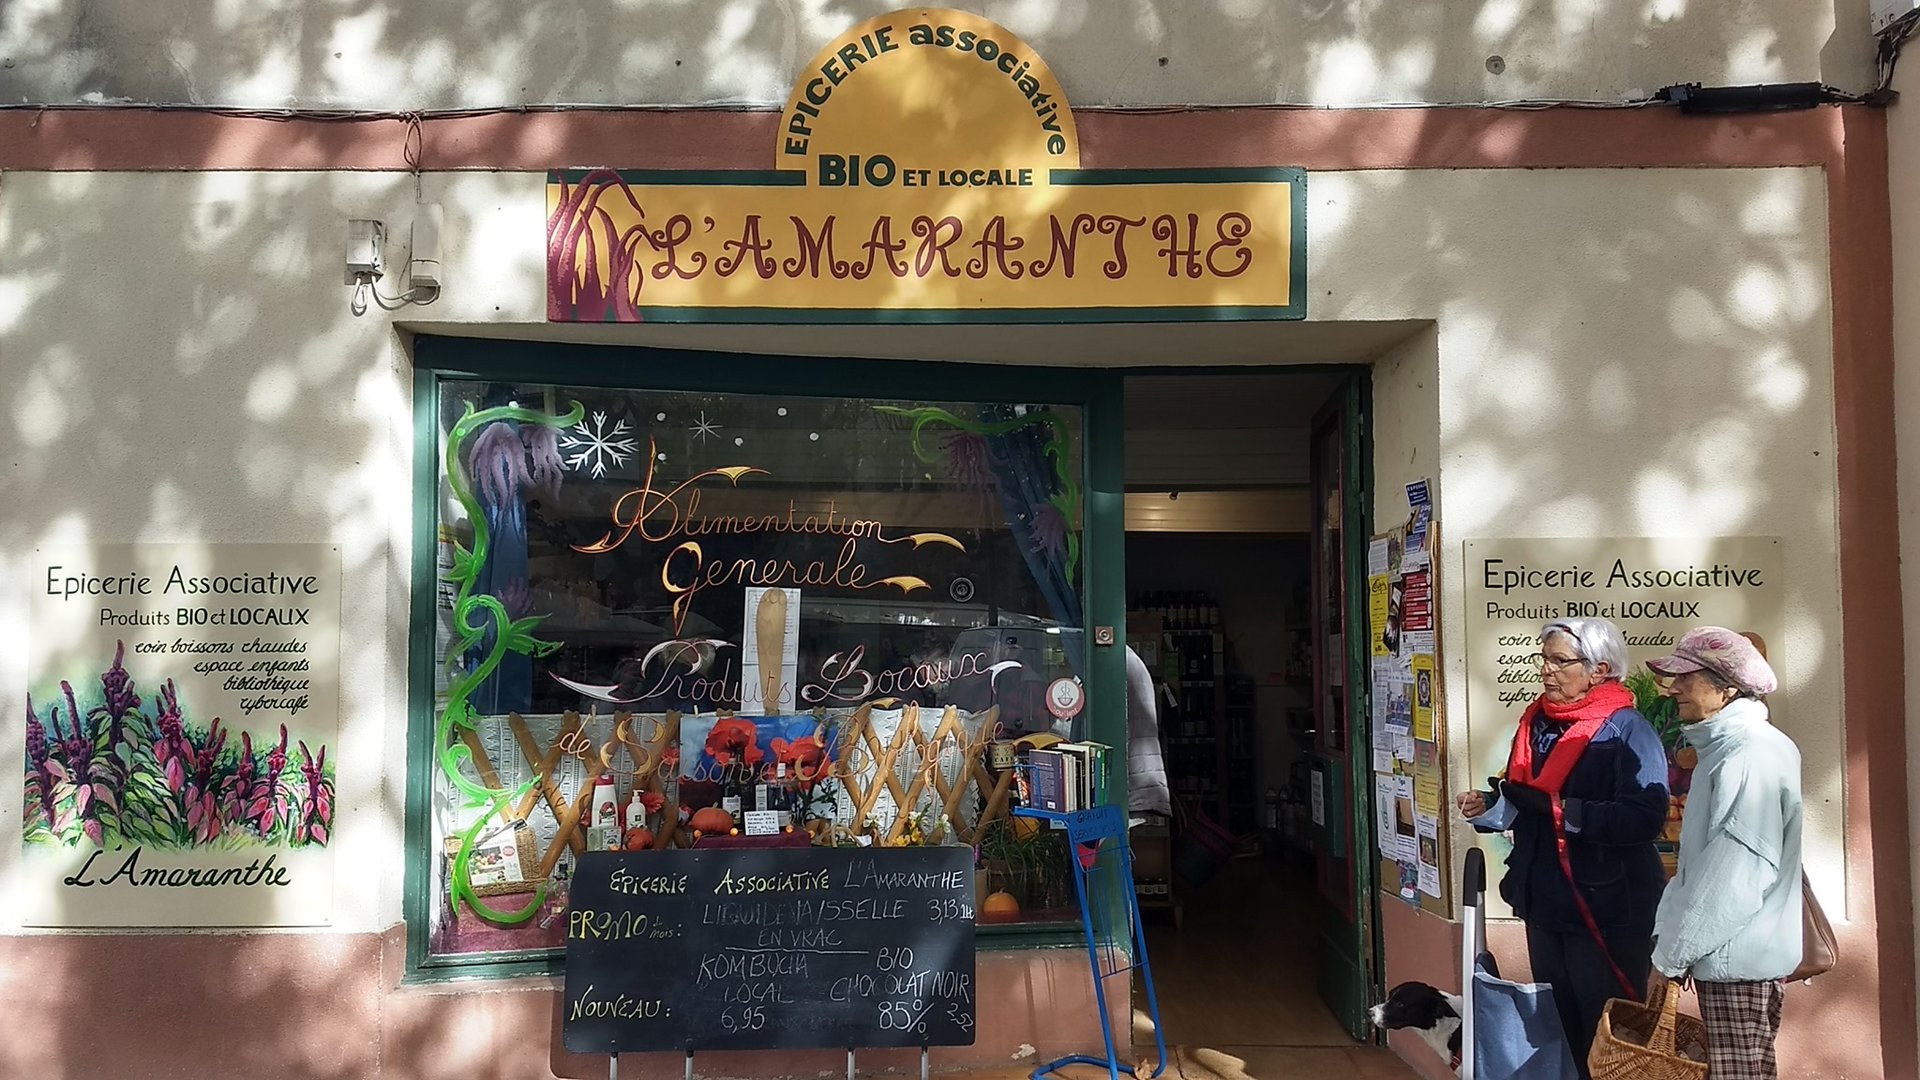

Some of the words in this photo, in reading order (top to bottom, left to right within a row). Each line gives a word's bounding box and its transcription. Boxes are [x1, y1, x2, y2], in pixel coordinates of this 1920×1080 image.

[785, 25, 899, 155] EPICERIE
[909, 24, 1066, 155] associative
[819, 154, 896, 187] BIO
[903, 169, 931, 187] ET
[939, 169, 1033, 187] LOCALE
[648, 212, 1254, 281] L'AMARANTHE
[575, 462, 900, 552] Alimentation
[47, 566, 153, 600] Epicerie
[164, 565, 319, 595] Associative
[1484, 559, 1596, 595] Epicerie
[1606, 558, 1764, 588] Associative
[100, 608, 170, 626] Produits
[176, 608, 208, 626] BIO
[210, 609, 226, 626] et
[230, 608, 310, 625] LOCAUX
[1487, 602, 1559, 619] Produits
[1601, 602, 1615, 618] et
[1621, 601, 1700, 618] LOCAUX
[135, 640, 167, 654] coin
[171, 638, 235, 654] boissons
[241, 638, 307, 653] chaudes
[1498, 633, 1533, 647] coin
[193, 660, 244, 677] espace
[251, 658, 310, 676] enfants
[801, 643, 992, 702] Locaux
[1497, 654, 1535, 670] espa
[222, 676, 310, 695] bibliothèque
[240, 695, 310, 716] cybercafé
[64, 844, 292, 888] L'Amaranthe
[844, 858, 965, 891] L'AMARANTHE
[567, 909, 648, 941] PROMO
[758, 928, 783, 947] EN
[790, 927, 843, 947] VRAC
[696, 952, 809, 985] KOMBUCHA
[876, 946, 914, 971] BIO
[723, 983, 796, 1004] LOCAL
[829, 970, 931, 1002] CHOCOLAT
[931, 971, 970, 1004] NOIR
[720, 1005, 766, 1031] 6,95
[877, 998, 935, 1034] 85%
